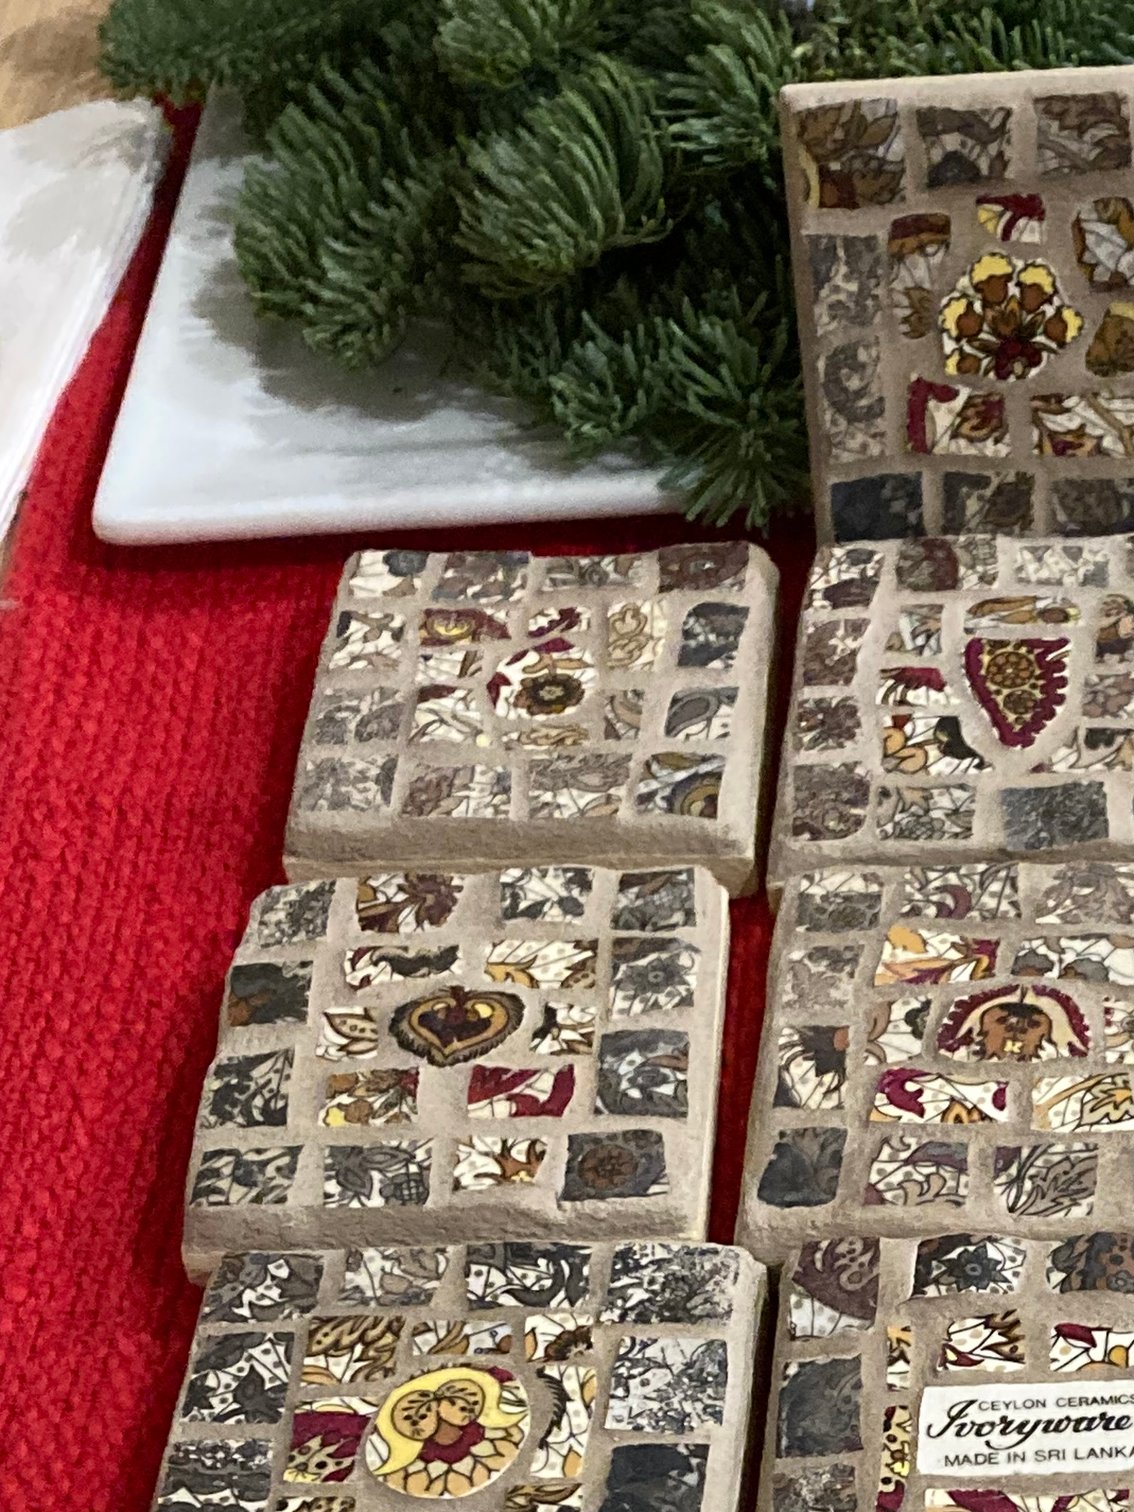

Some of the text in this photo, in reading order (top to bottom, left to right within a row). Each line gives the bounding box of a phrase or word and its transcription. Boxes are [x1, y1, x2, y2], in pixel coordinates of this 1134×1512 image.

[978, 1399, 1046, 1411] CEYLON
[926, 1399, 1134, 1451] Ivoryware
[944, 1451, 1000, 1467] MADE
[1006, 1450, 1026, 1463] IN
[1034, 1448, 1066, 1462] SRI
